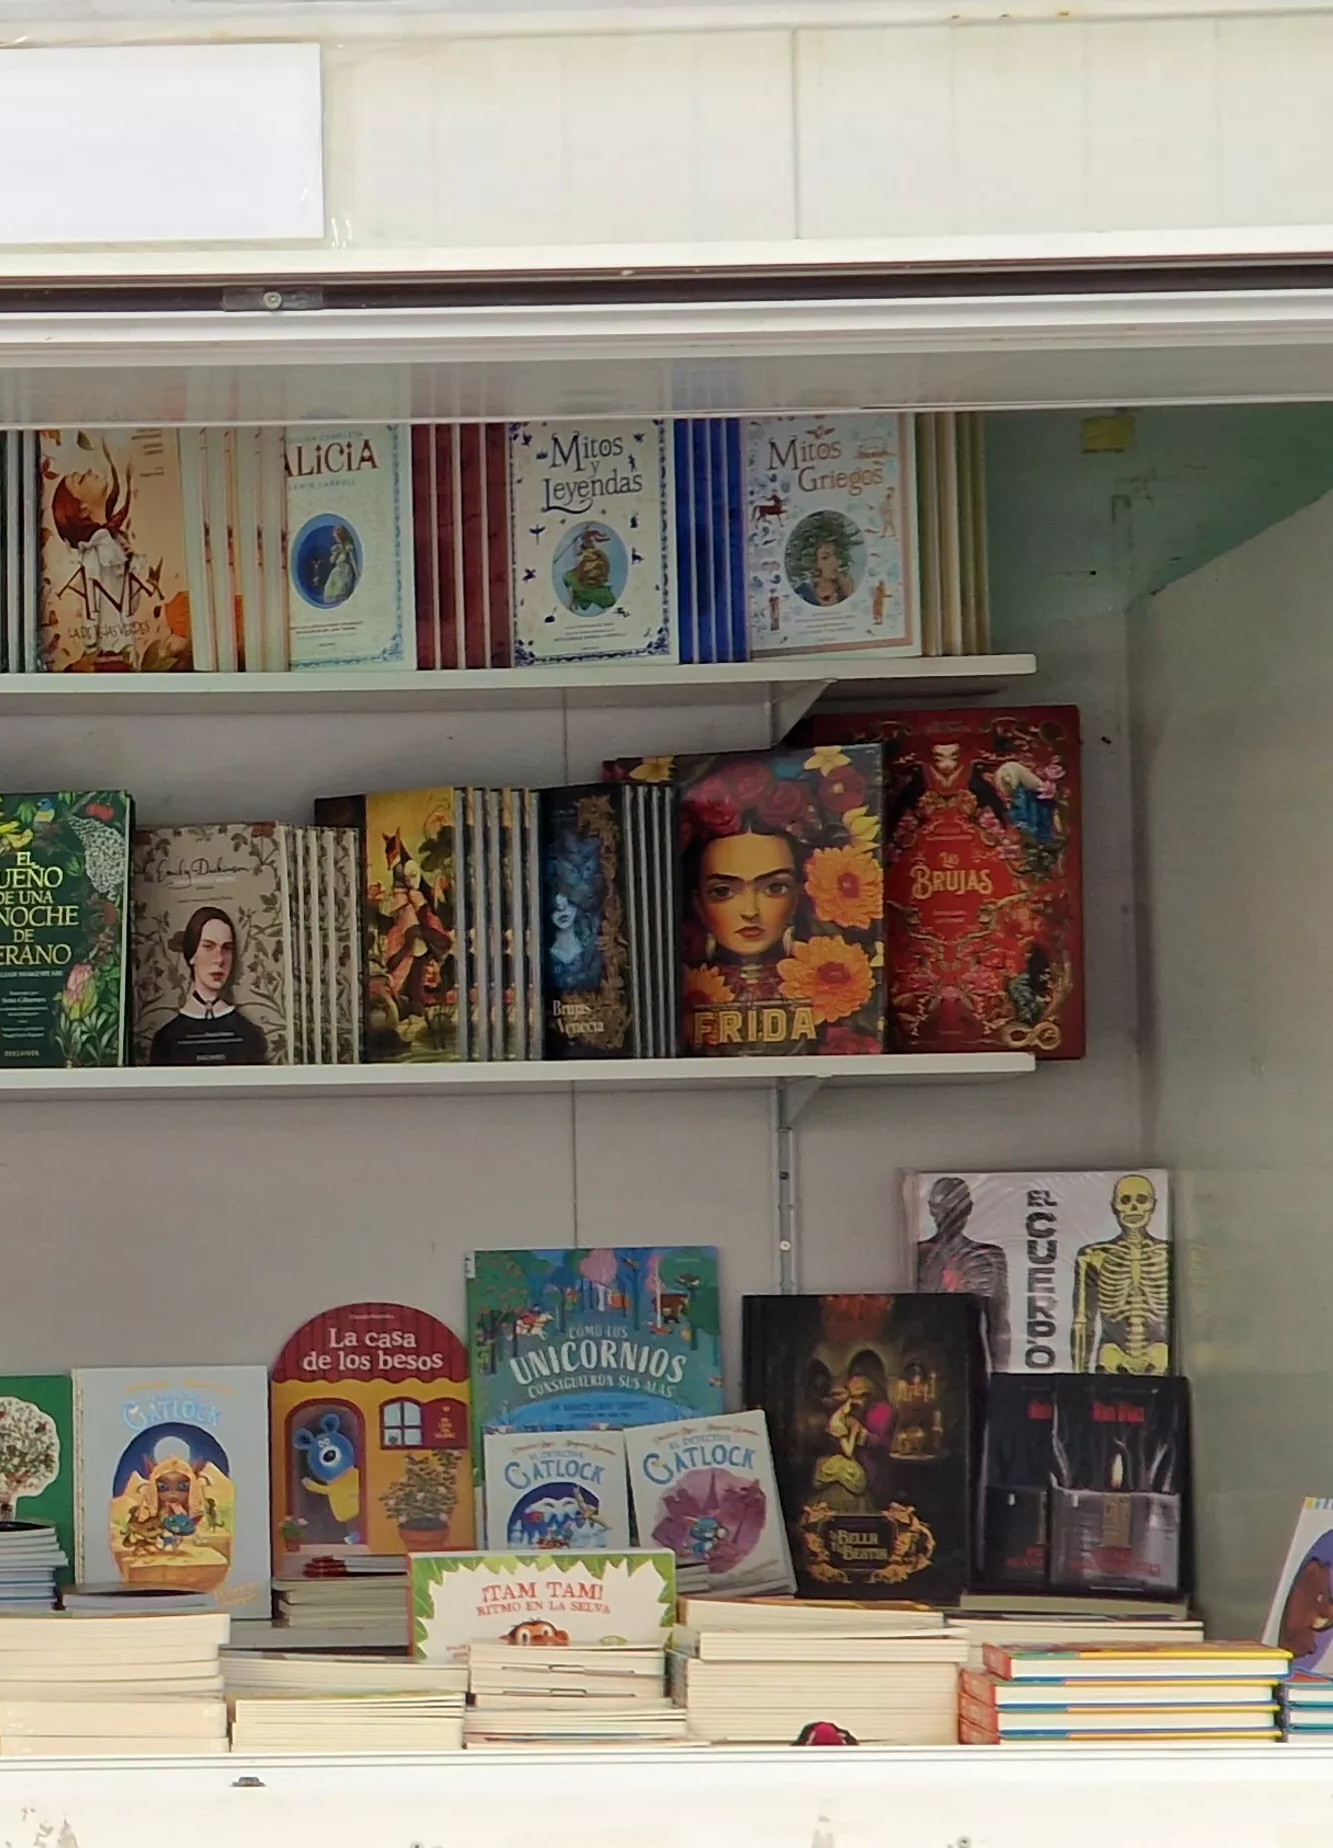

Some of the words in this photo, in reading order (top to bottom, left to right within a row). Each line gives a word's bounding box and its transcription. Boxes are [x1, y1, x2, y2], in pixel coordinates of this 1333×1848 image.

[548, 430, 624, 472] Mitos
[766, 434, 842, 471] Mitos
[587, 459, 601, 480] y
[797, 465, 884, 497] Griegos
[540, 467, 644, 515] Leyendas
[55, 552, 165, 621] ANA
[16, 851, 40, 868] EL
[909, 864, 994, 900] BRUJAS
[19, 889, 54, 904] UNA
[13, 928, 35, 943] DE
[694, 1006, 818, 1044] FRIDA
[329, 1328, 358, 1348] La
[364, 1330, 417, 1349] casa
[303, 1351, 332, 1371] de
[338, 1351, 372, 1371] los
[378, 1350, 444, 1371] besos
[509, 1339, 687, 1386] UNICORNIOS
[527, 1373, 615, 1399] CONSIGUIERON
[618, 1374, 641, 1390] SUS
[547, 1581, 604, 1600] TAM!
[476, 1602, 521, 1617] RITMO
[526, 1601, 543, 1611] EN
[549, 1600, 566, 1611] LA
[570, 1601, 611, 1615] SELVA
